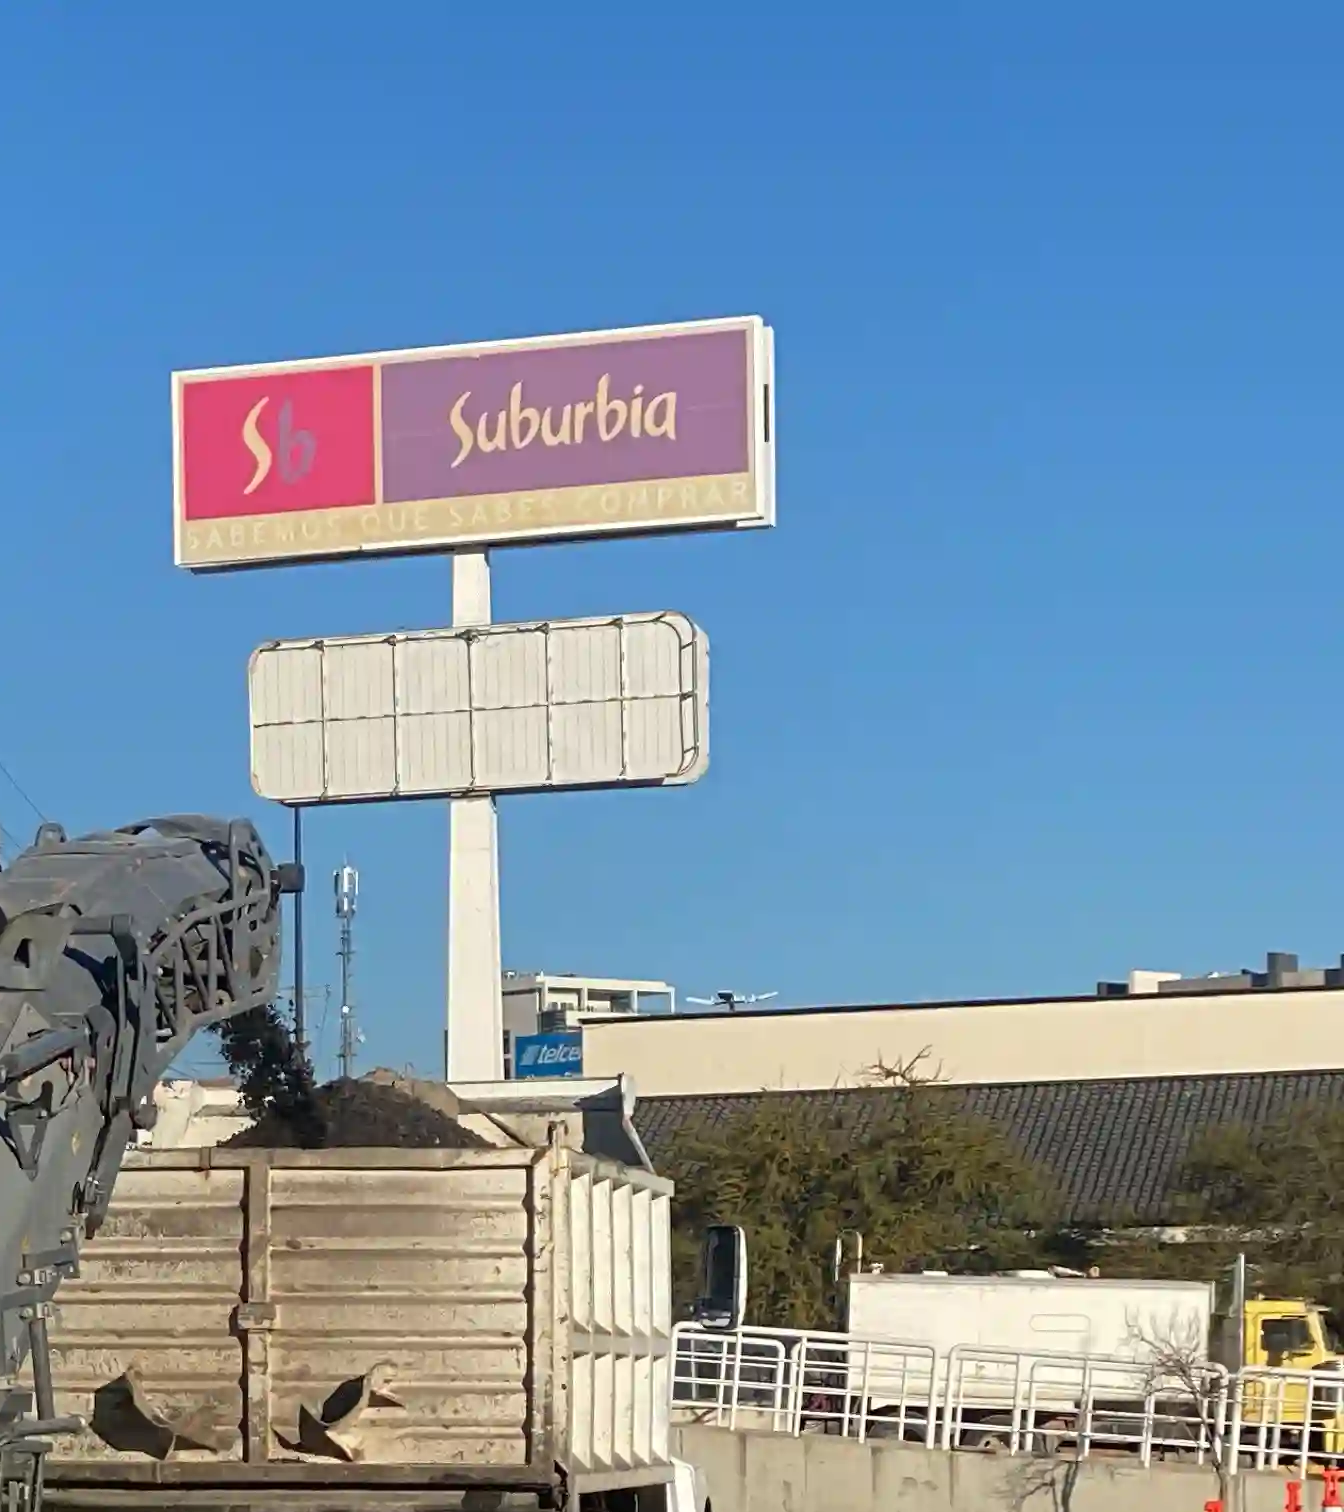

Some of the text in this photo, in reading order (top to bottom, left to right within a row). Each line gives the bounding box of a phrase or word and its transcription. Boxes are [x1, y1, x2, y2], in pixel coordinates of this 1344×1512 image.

[450, 373, 677, 468] Suburbia
[186, 478, 749, 550] SABEMOS QUE SABES COMPRAR
